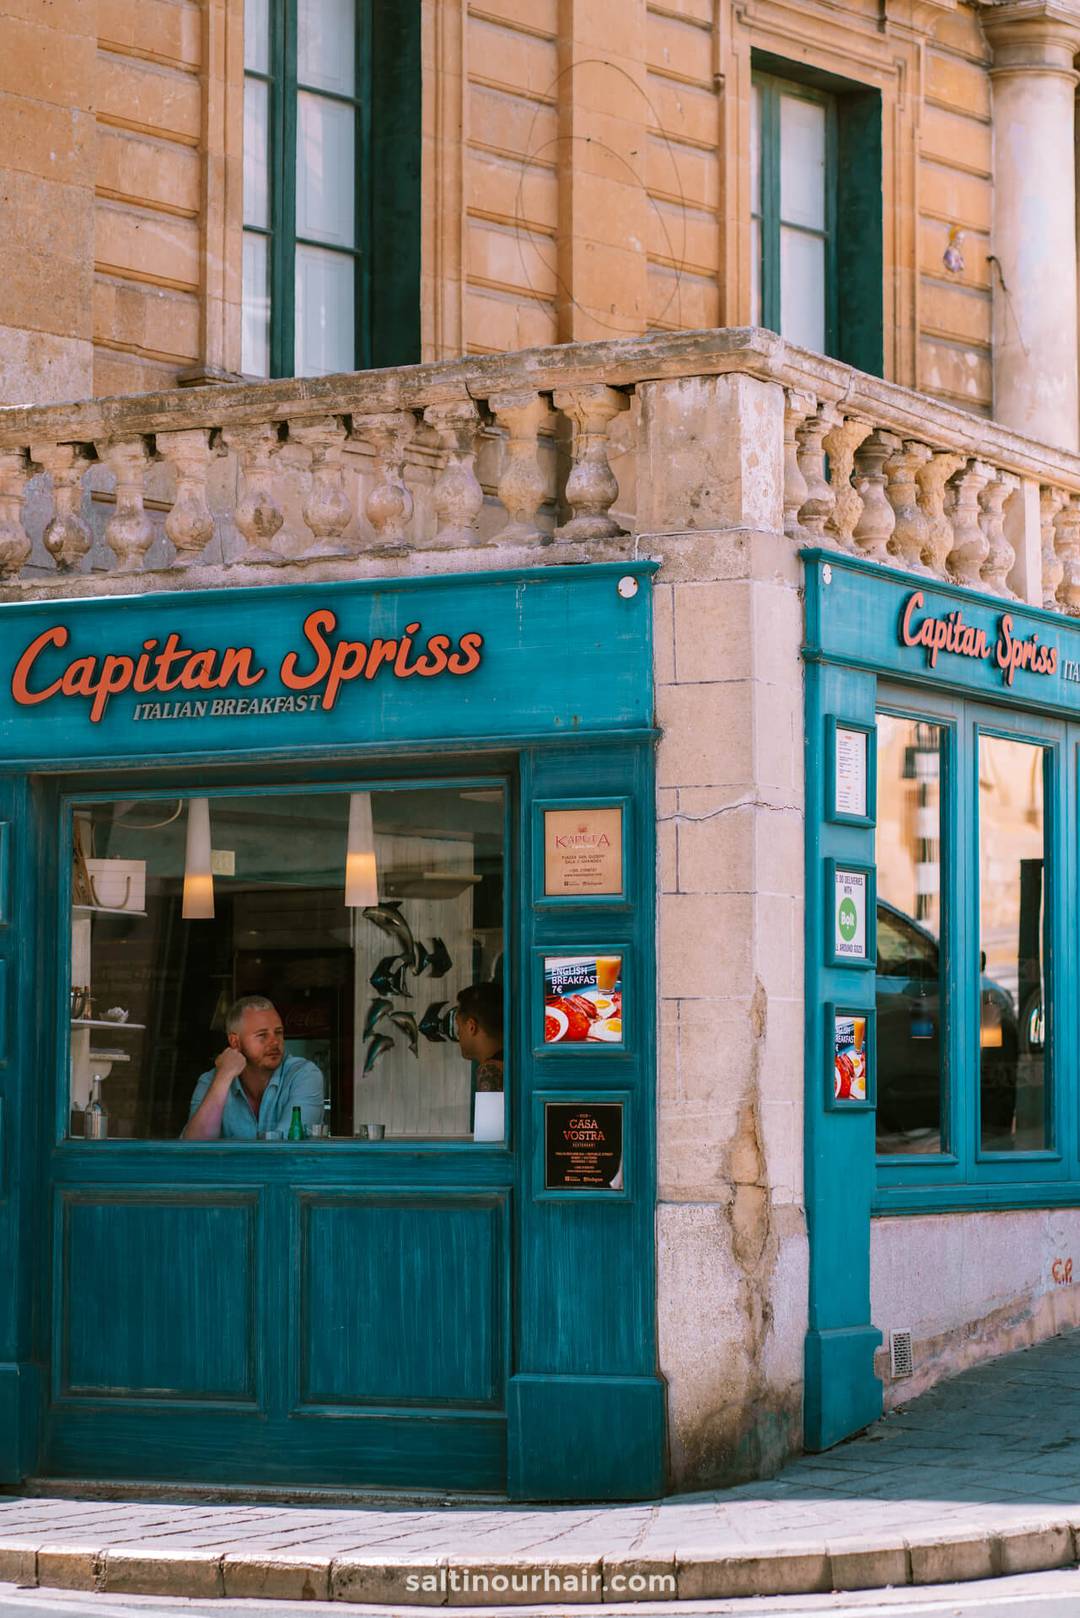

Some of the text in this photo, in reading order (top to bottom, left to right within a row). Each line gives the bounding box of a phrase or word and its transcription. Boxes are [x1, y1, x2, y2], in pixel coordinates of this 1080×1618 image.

[903, 591, 1057, 687] Capitan Spriss
[11, 609, 483, 723] Capitan Spriss
[133, 694, 321, 721] ITALIAN BREAKFAST
[551, 967, 588, 976] ENGLISH
[551, 976, 600, 985] BREAKFAST
[551, 985, 563, 994] 7€
[569, 1119, 598, 1129] CASA
[563, 1130, 605, 1141] VOSTRA
